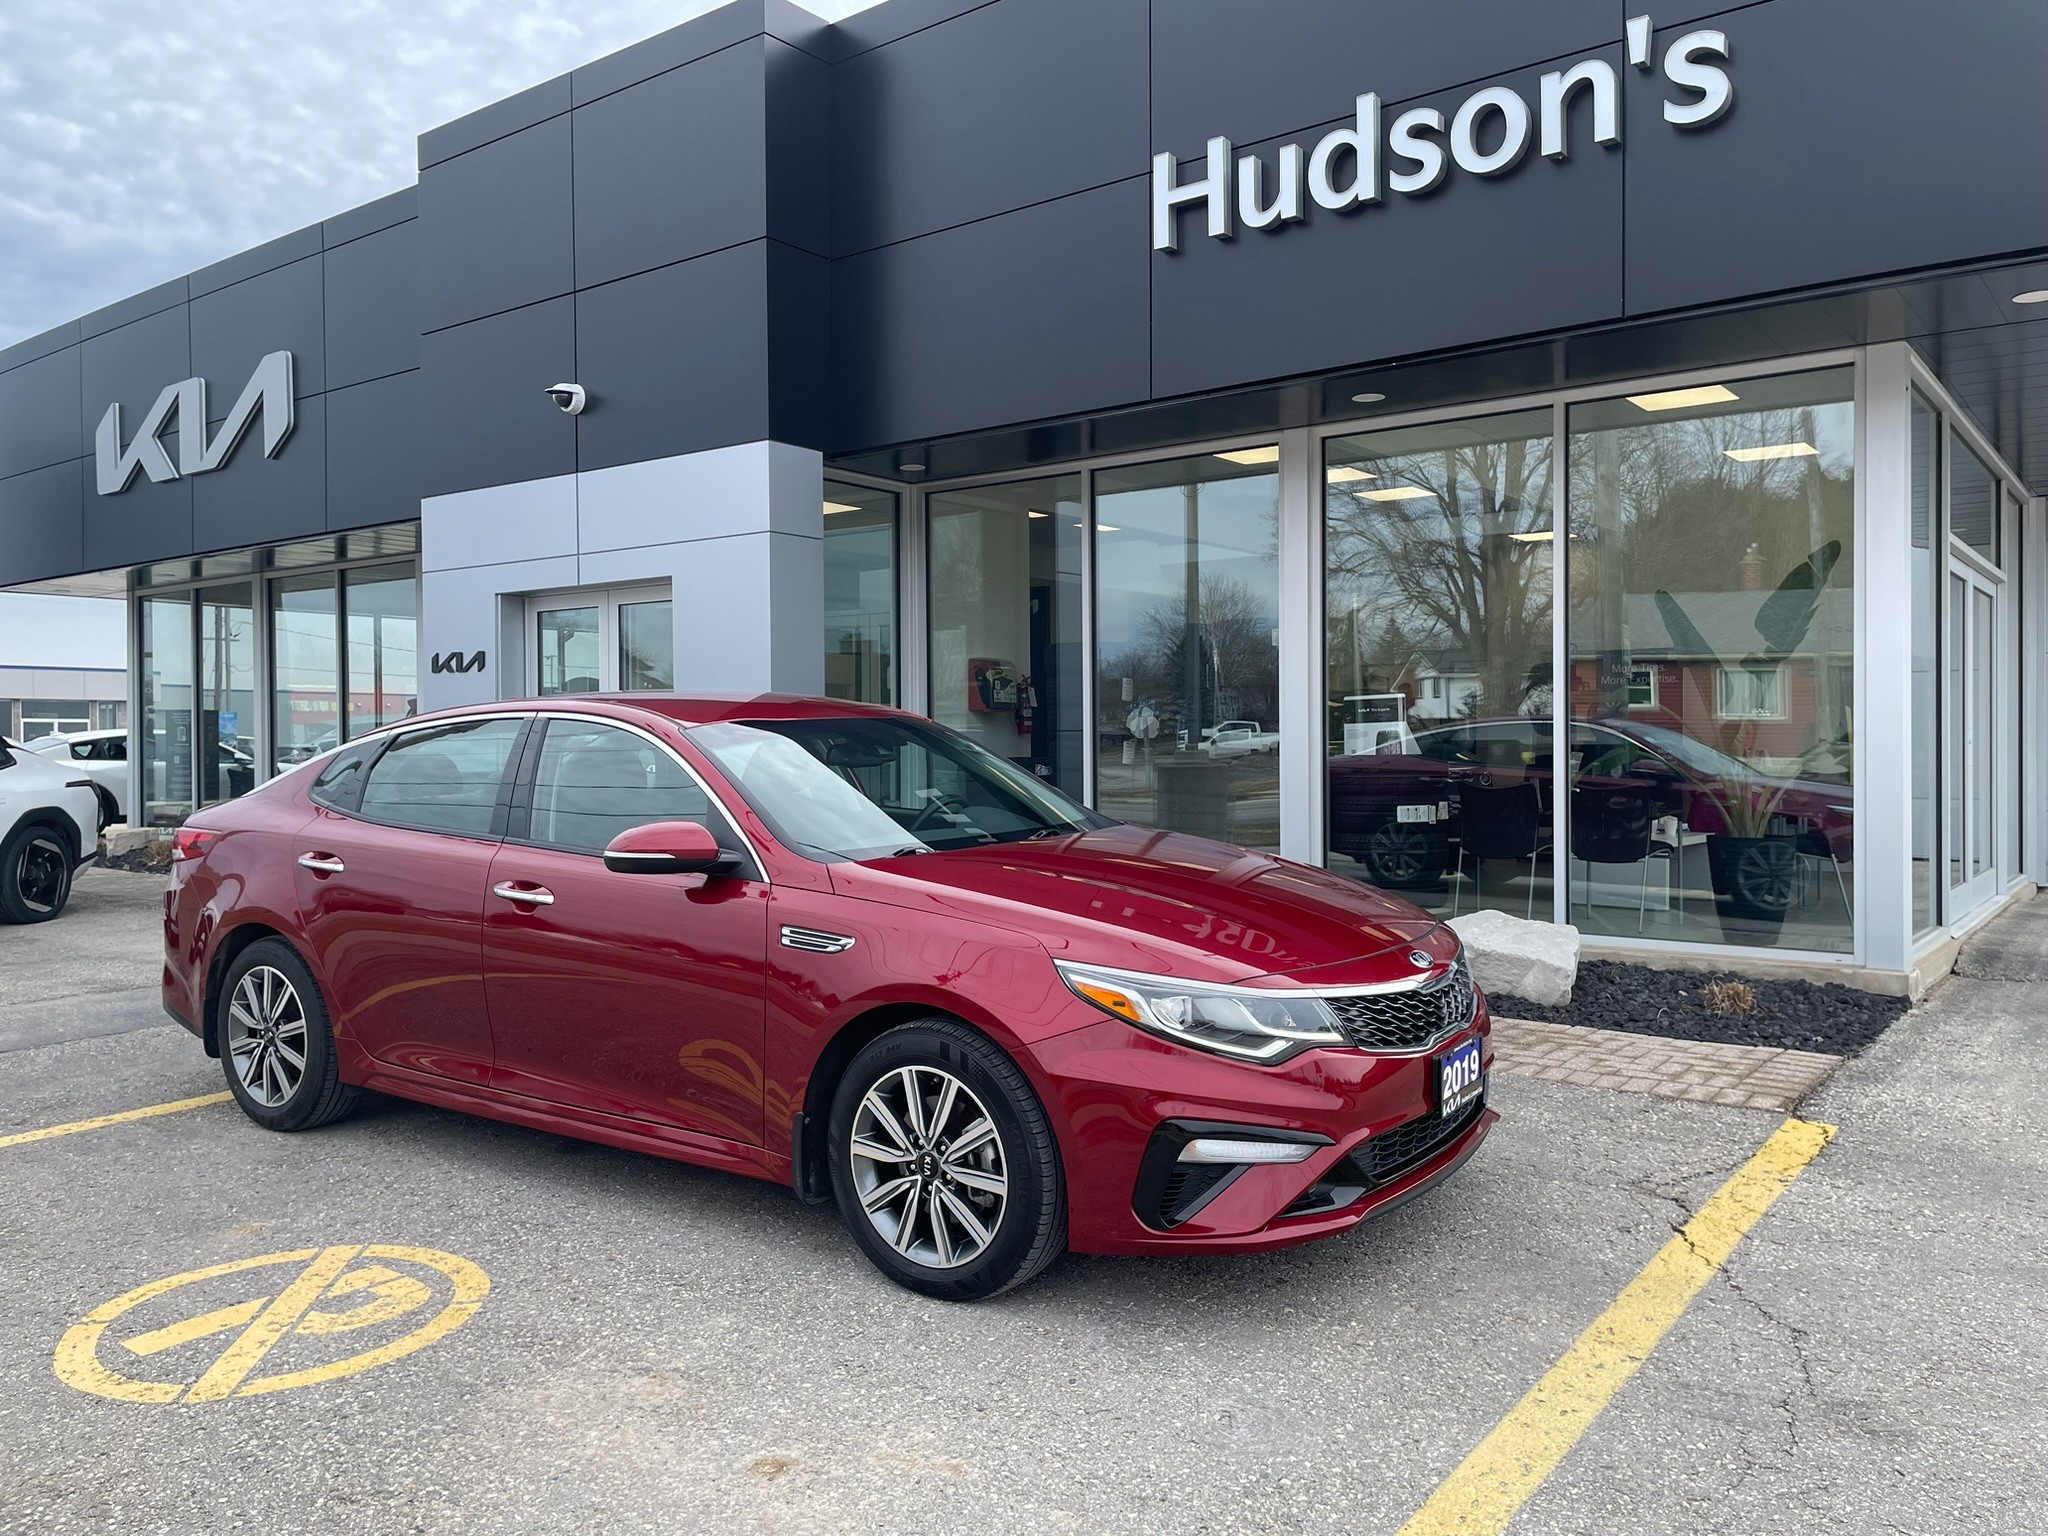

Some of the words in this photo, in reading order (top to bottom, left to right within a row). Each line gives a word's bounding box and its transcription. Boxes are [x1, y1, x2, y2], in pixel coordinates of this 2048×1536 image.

[1153, 15, 1734, 254] Hudson's
[96, 350, 294, 495] KIA
[431, 650, 486, 674] KIA
[1611, 664, 1638, 673] More
[1642, 663, 1667, 672] Tires.
[1600, 676, 1626, 685] More
[1629, 674, 1679, 685] Expertise.
[1443, 1049, 1480, 1101] 2019
[924, 1156, 932, 1176] KIA
